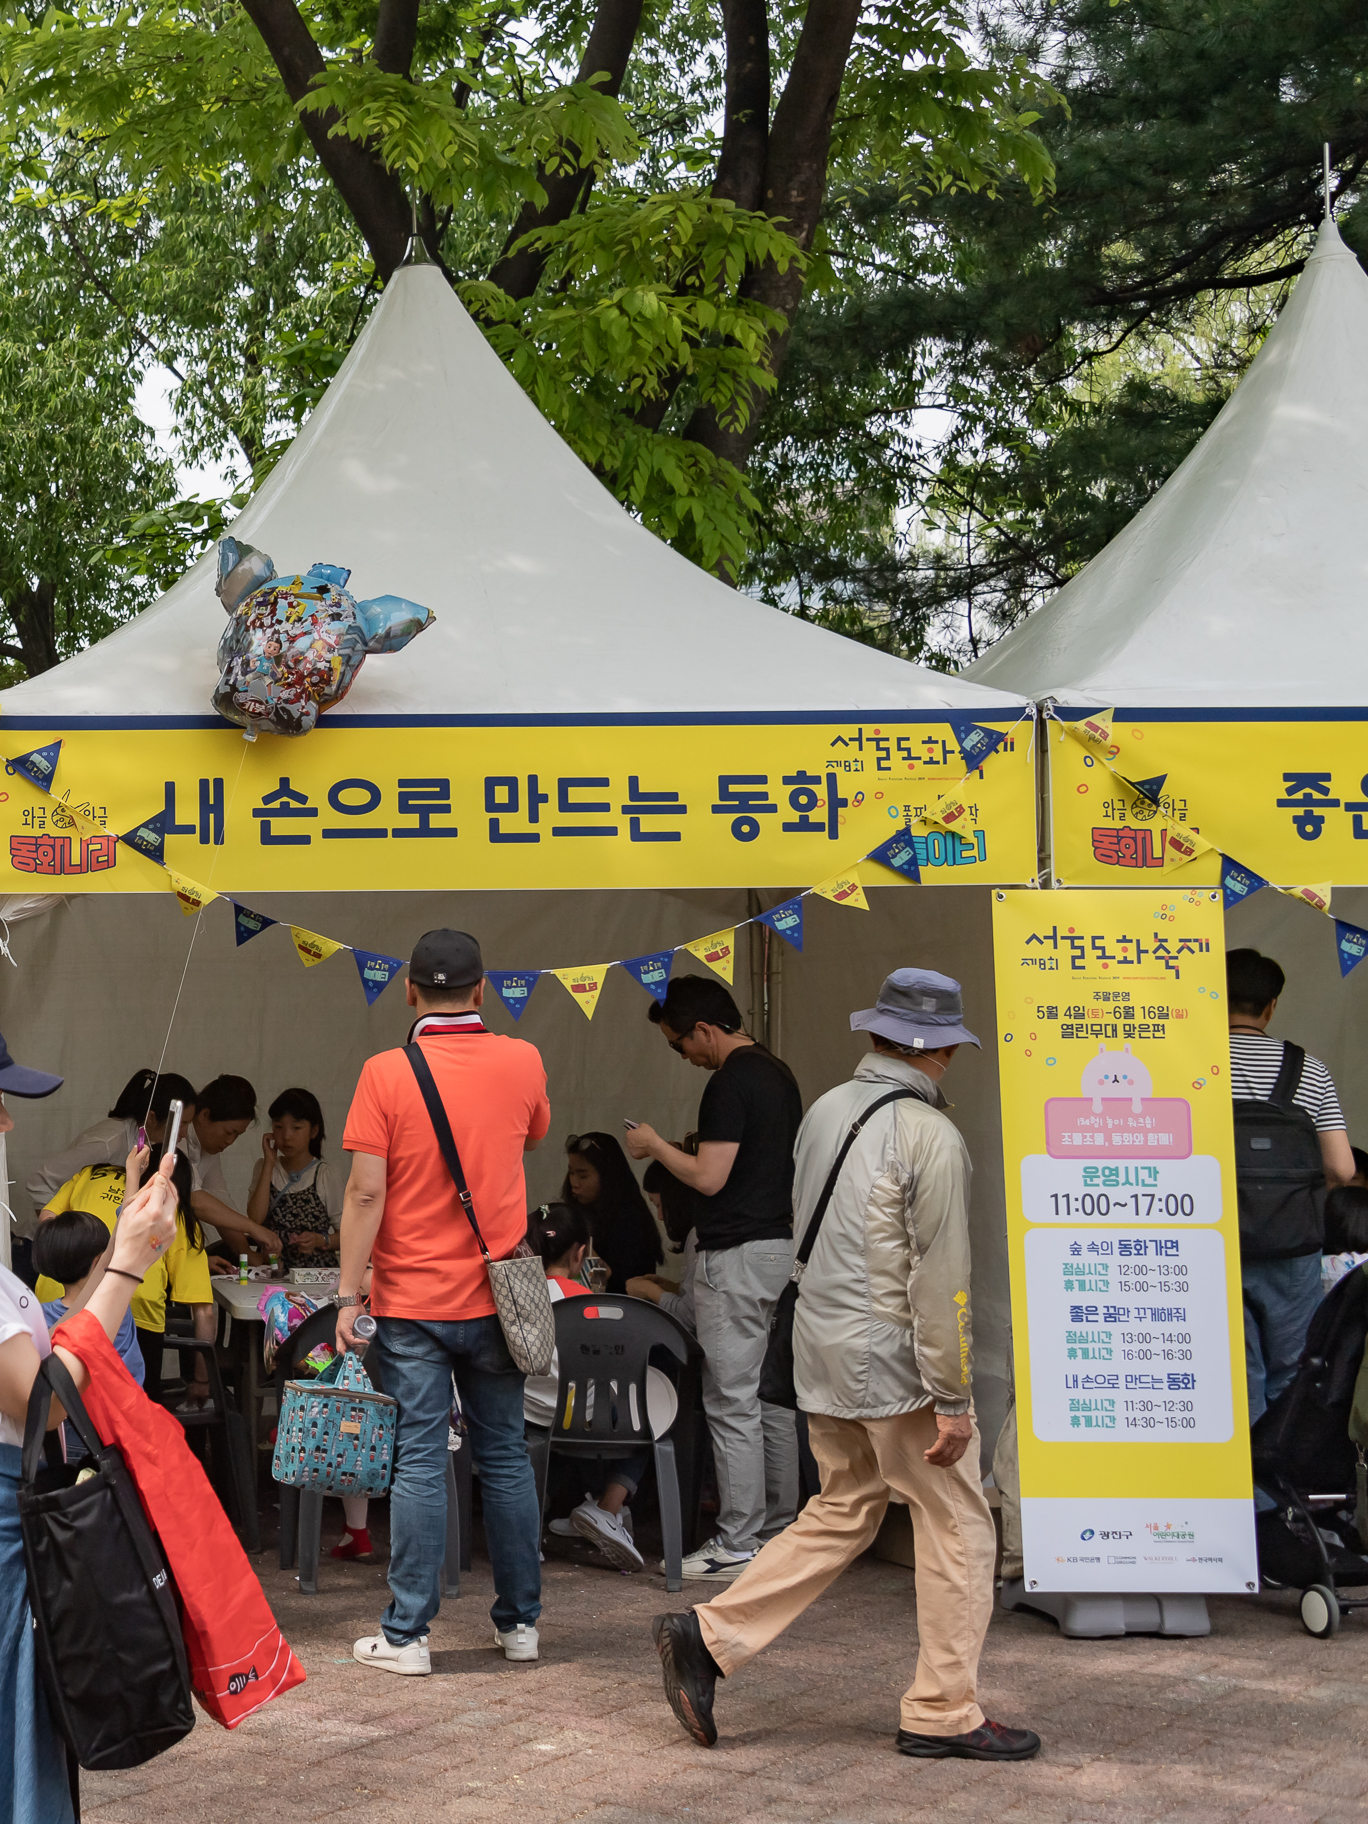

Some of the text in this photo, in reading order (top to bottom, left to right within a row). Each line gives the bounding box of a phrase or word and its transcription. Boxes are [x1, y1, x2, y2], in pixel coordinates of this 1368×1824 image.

[826, 758, 864, 772] 제8회
[164, 770, 848, 845] 내 손으로 만드는 동화
[1102, 799, 1127, 821] 와글
[22, 806, 47, 829] 와글
[10, 833, 119, 875] 동화나라
[1092, 826, 1199, 868] 동화나
[1025, 926, 1210, 979] 서울동화축제
[1021, 956, 1058, 970] 제8회
[1093, 991, 1131, 1002] 주말운영
[1036, 1006, 1188, 1020] 5월 4일(토)-6월 16일(일)
[1061, 1023, 1165, 1039] 열린무대 맞은편
[1111, 1133, 1144, 1146] 동화와
[1082, 1166, 1159, 1187] 운영시간
[1050, 1193, 1194, 1217] 11:00~17:00
[1069, 1239, 1179, 1257] 숲 속의 동화가면
[1062, 1263, 1188, 1276] 점심시간 12:00~13:00
[1063, 1279, 1189, 1292] 휴게시간 15:00~15:30
[1069, 1305, 1186, 1323] 좋은 꿈만 꾸게해줘
[1065, 1331, 1191, 1344] 점심시간 13:00~14:00
[1066, 1347, 1192, 1360] 휴게시간 16:00~16:30
[1065, 1372, 1196, 1390] 내 손으로 만드는 동화
[1068, 1398, 1193, 1412] 점심시간 11:30~12:30
[1069, 1414, 1196, 1428] 휴게시간 14:30~15:00
[1099, 1531, 1133, 1540] 광진구
